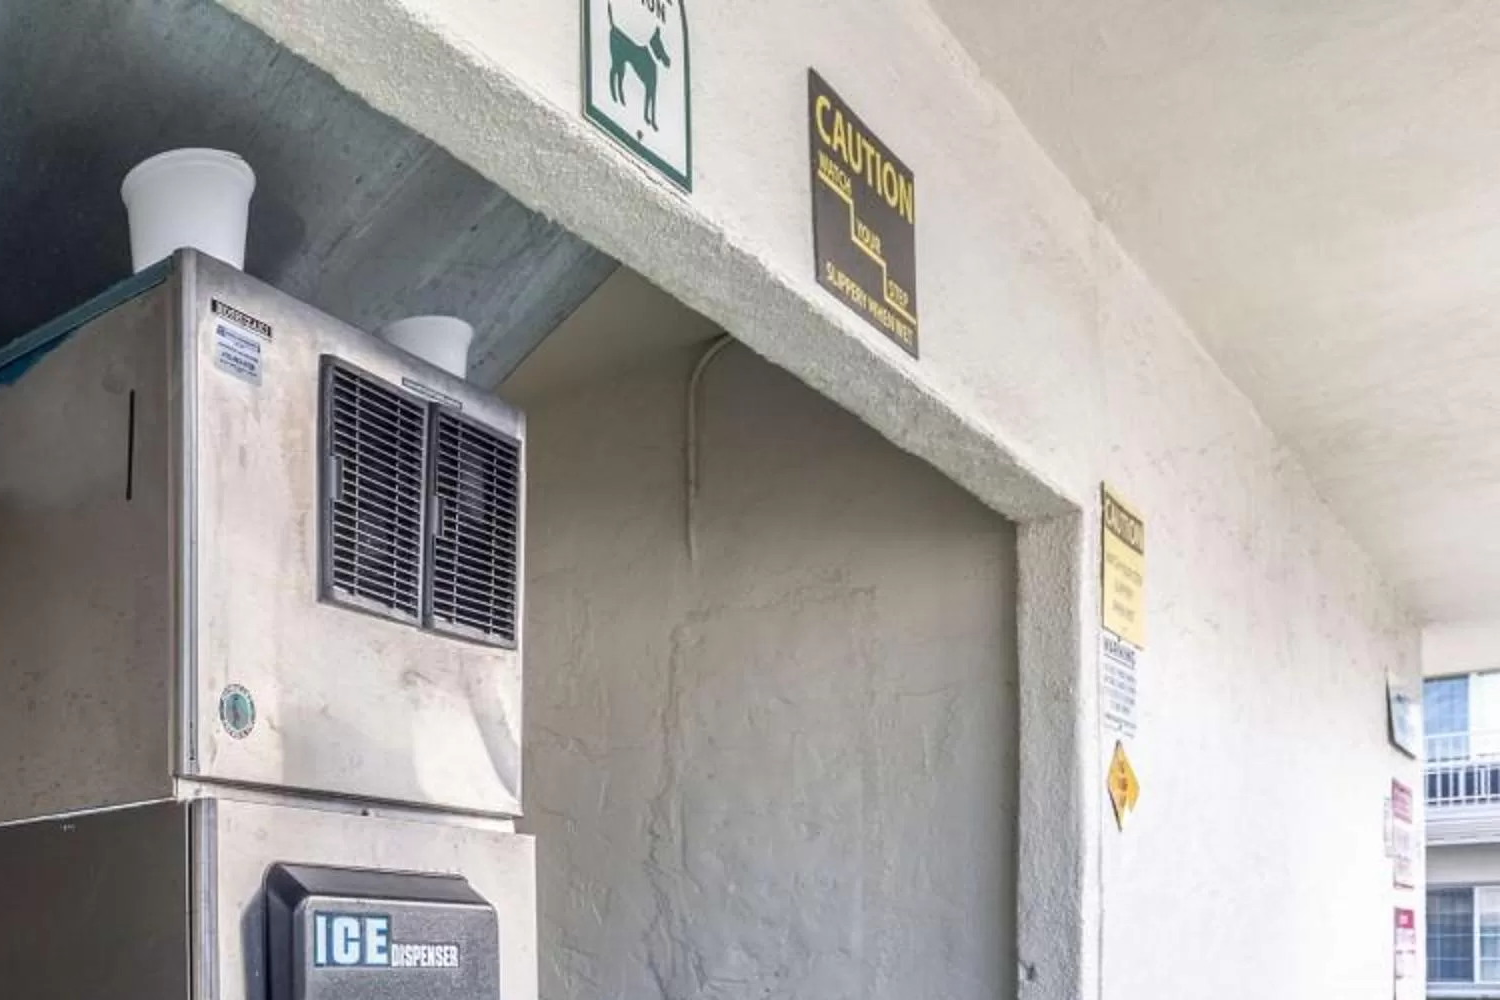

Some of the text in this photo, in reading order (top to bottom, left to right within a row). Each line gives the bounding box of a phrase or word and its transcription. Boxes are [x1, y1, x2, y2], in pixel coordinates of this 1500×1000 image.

[815, 94, 913, 225] CAUTION
[818, 149, 851, 196] WATCH
[855, 217, 881, 255] YOUR
[887, 278, 909, 310] STEP
[315, 915, 459, 967] ICE DISPENSER
